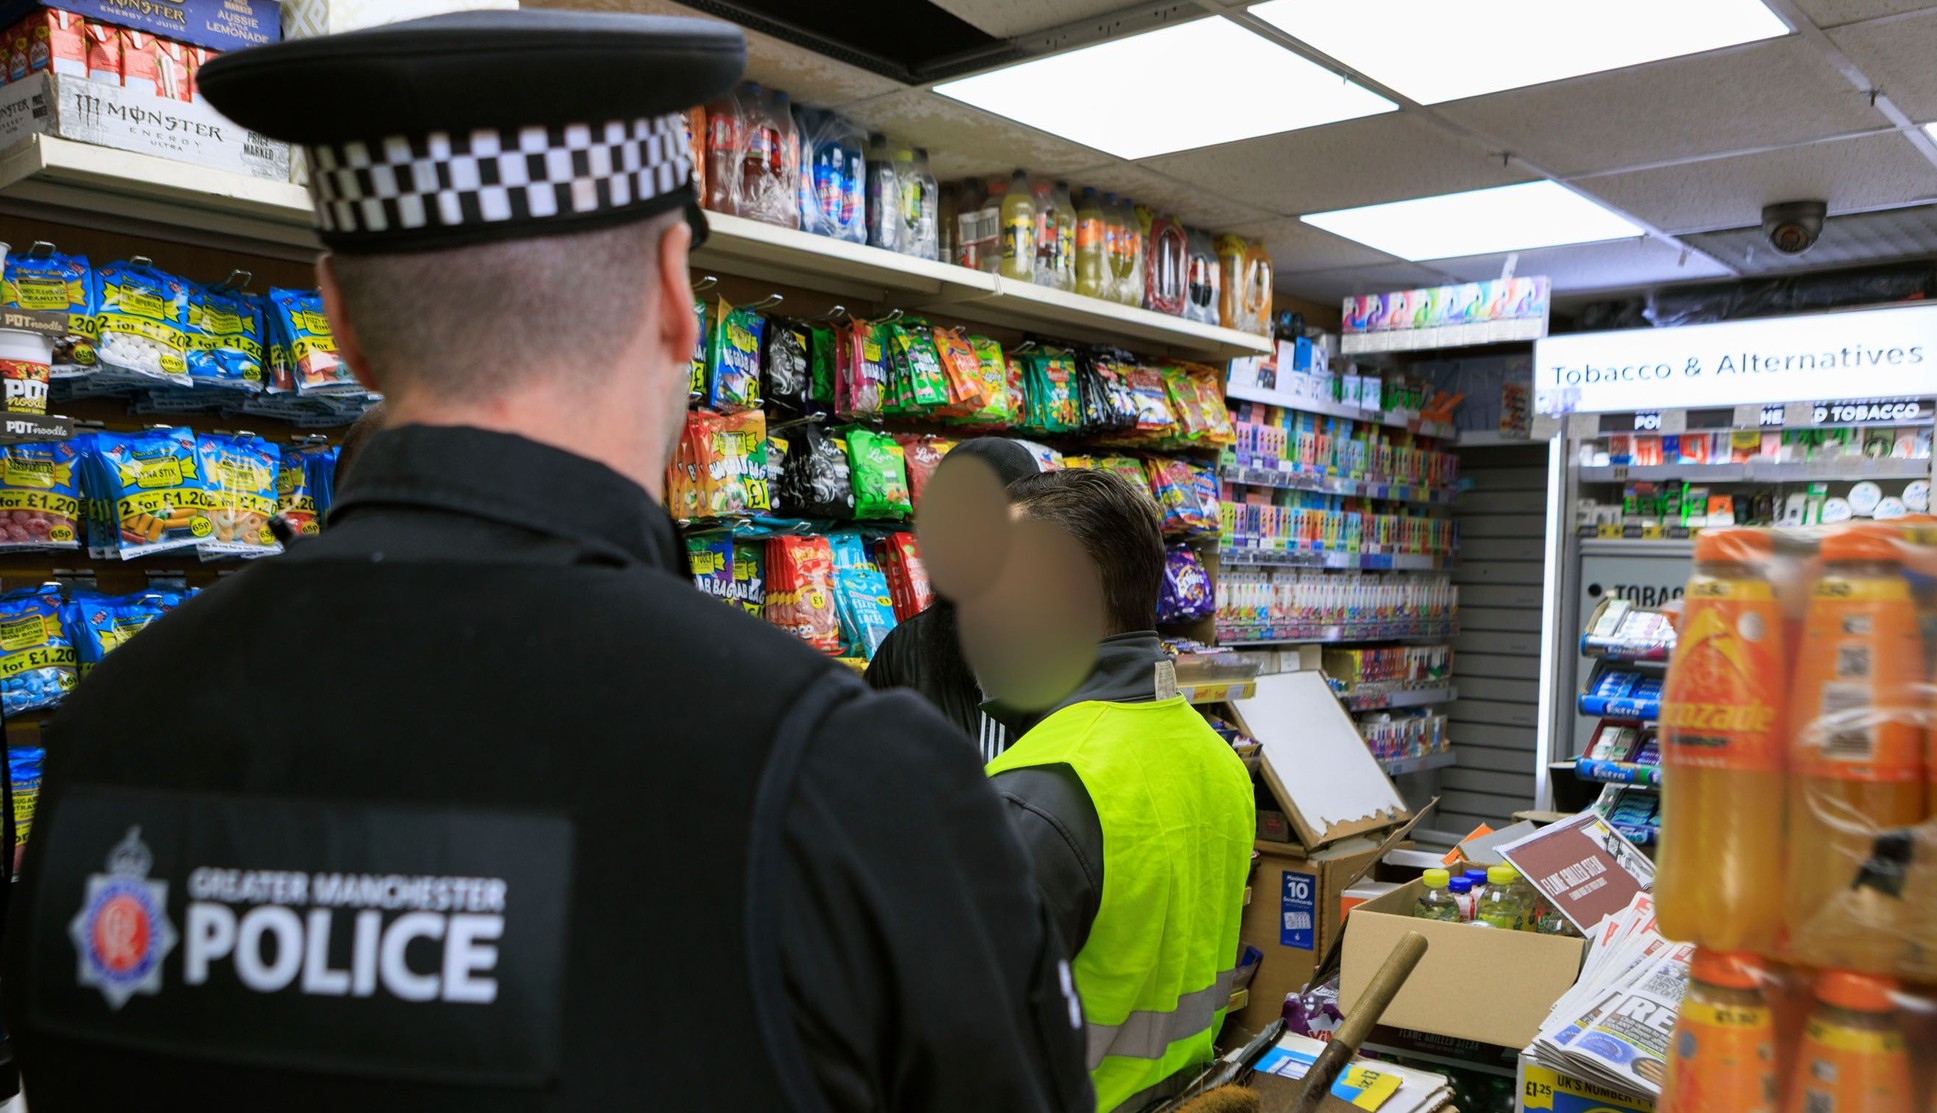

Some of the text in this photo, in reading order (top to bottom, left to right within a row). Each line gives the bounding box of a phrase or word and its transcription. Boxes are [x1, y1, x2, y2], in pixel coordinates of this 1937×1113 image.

[101, 6, 142, 21] ENERGY
[156, 20, 186, 32] JUICE
[217, 9, 259, 29] AUSSIE
[206, 20, 269, 44] LEMONADE
[108, 101, 223, 142] MONSTER
[129, 126, 202, 149] ENERGY
[150, 139, 184, 152] ULTRA
[243, 143, 274, 160] MARKED
[5, 314, 63, 331] POT noodle
[99, 315, 185, 348] 2 for £1.20
[224, 338, 262, 357] £1.20
[296, 342, 306, 355] 2
[1552, 344, 1924, 385] Tobacco & Alternatives
[4, 379, 49, 402] POT
[1760, 408, 1786, 425] HE
[1831, 402, 1920, 421] TOBACCO
[6, 421, 68, 436] POT noodle
[818, 437, 841, 455] Lion
[868, 447, 893, 463] Lion
[915, 447, 940, 463] Lion
[160, 469, 175, 478] STIX
[120, 492, 207, 515] 2 for £1.20
[750, 482, 765, 506] £1
[27, 494, 77, 515] £1.20
[241, 496, 277, 515] £1.20
[51, 529, 71, 539] 65p
[193, 522, 209, 531] 65p
[713, 579, 734, 598] BAG
[813, 597, 823, 605] £1
[3, 649, 75, 673] for £1.20
[1606, 702, 1640, 715] Extra
[1593, 767, 1625, 780] Extra
[188, 866, 506, 912] GREATER MANCHESTER
[1288, 882, 1309, 899] 10
[184, 903, 504, 1004] POLICE
[1525, 1081, 1551, 1097] £1.25
[1557, 1075, 1582, 1091] UK'S
